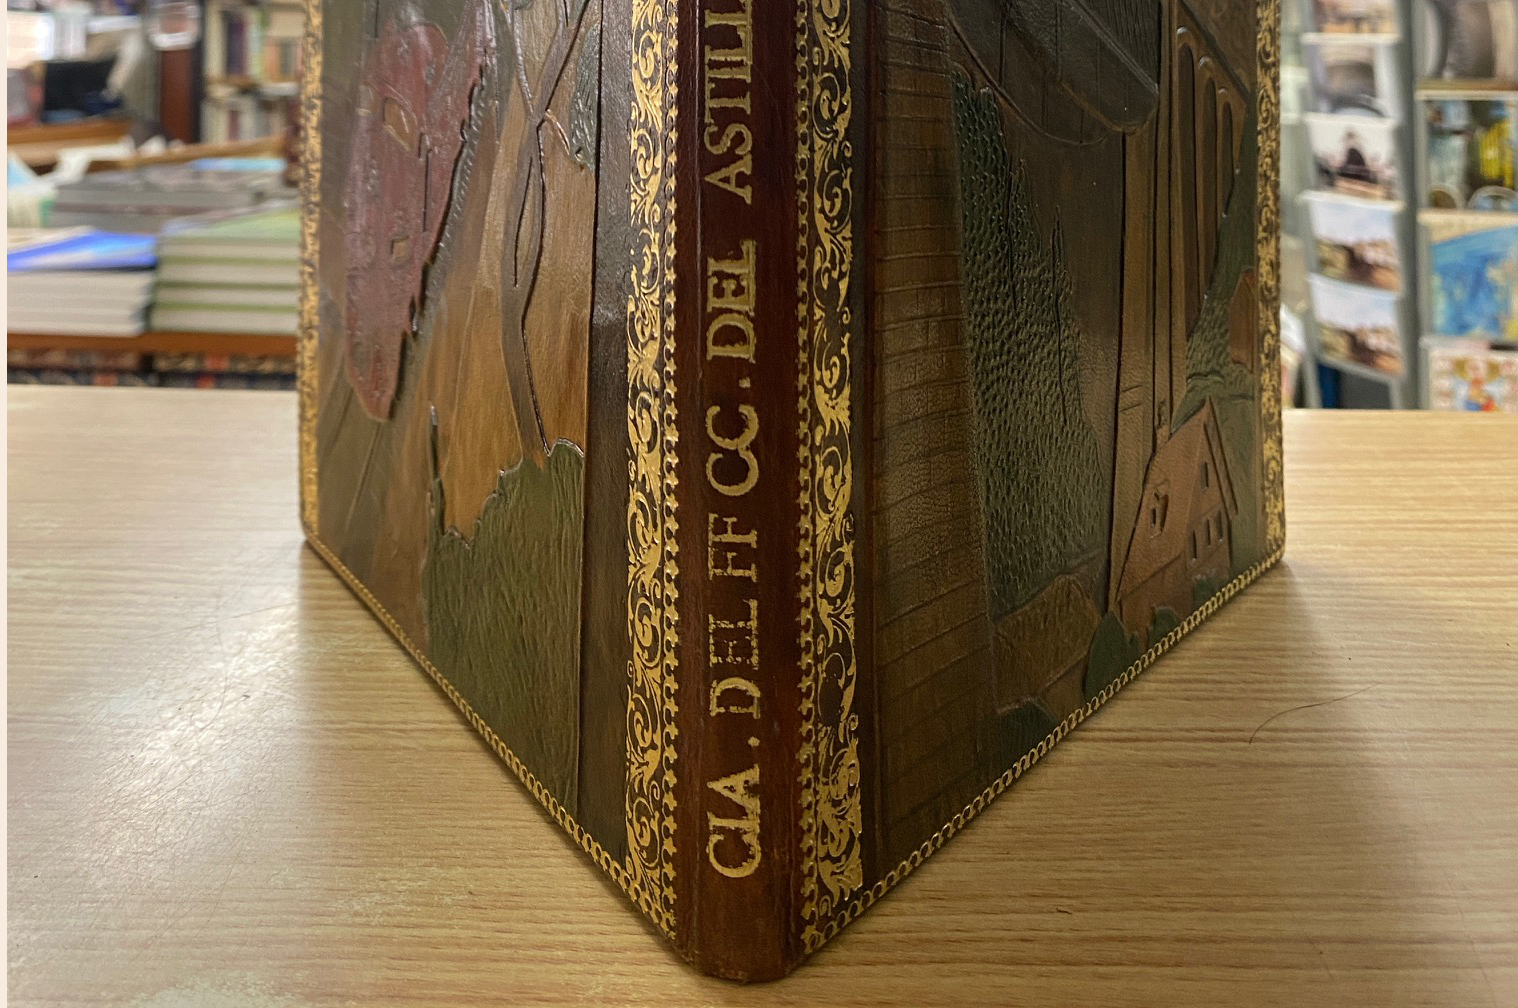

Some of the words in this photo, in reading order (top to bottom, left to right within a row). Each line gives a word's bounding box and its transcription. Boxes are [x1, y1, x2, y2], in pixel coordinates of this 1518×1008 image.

[706, 239, 757, 364] DEL
[708, 511, 759, 583] FF
[708, 598, 761, 720] DEL
[706, 735, 761, 879] CIA.
